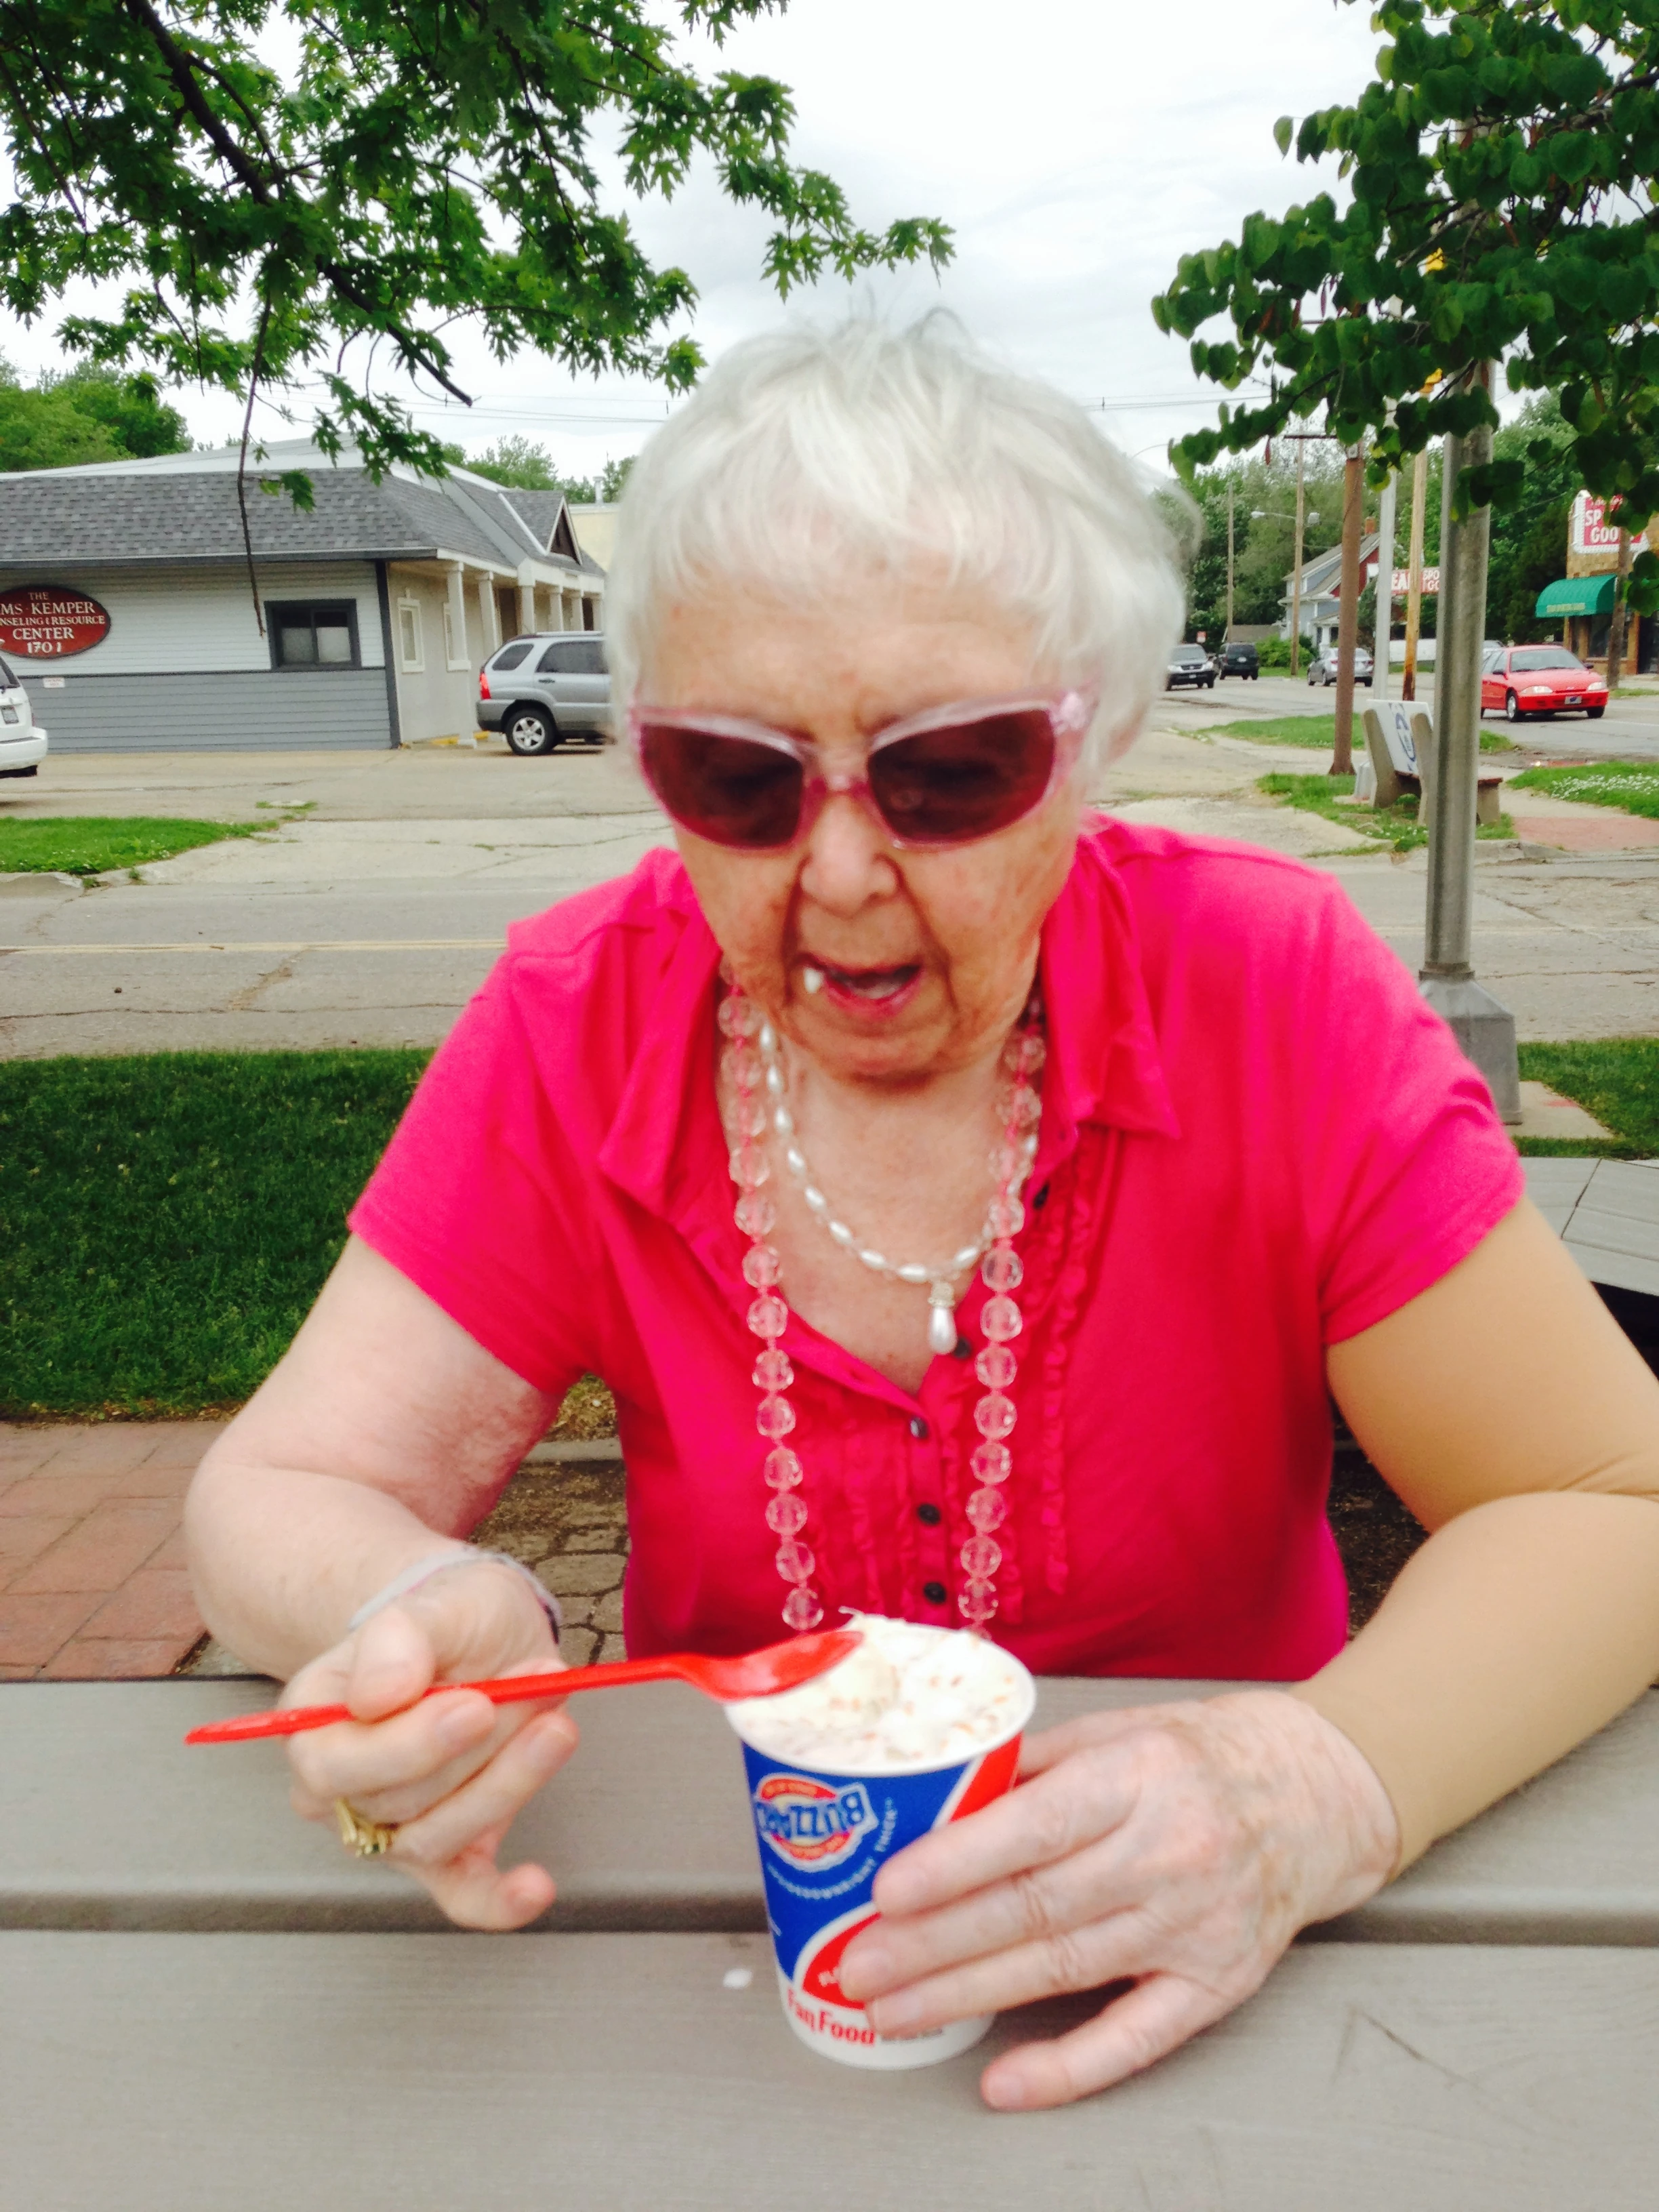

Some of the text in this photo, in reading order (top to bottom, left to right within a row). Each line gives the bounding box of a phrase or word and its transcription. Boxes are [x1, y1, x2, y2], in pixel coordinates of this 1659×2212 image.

[1591, 526, 1619, 544] GOO
[28, 592, 49, 600] THE
[0, 601, 96, 615] MS KEMPER
[0, 617, 43, 626] NSELING
[51, 615, 106, 625] RESOURCE
[12, 626, 75, 640] CENTER
